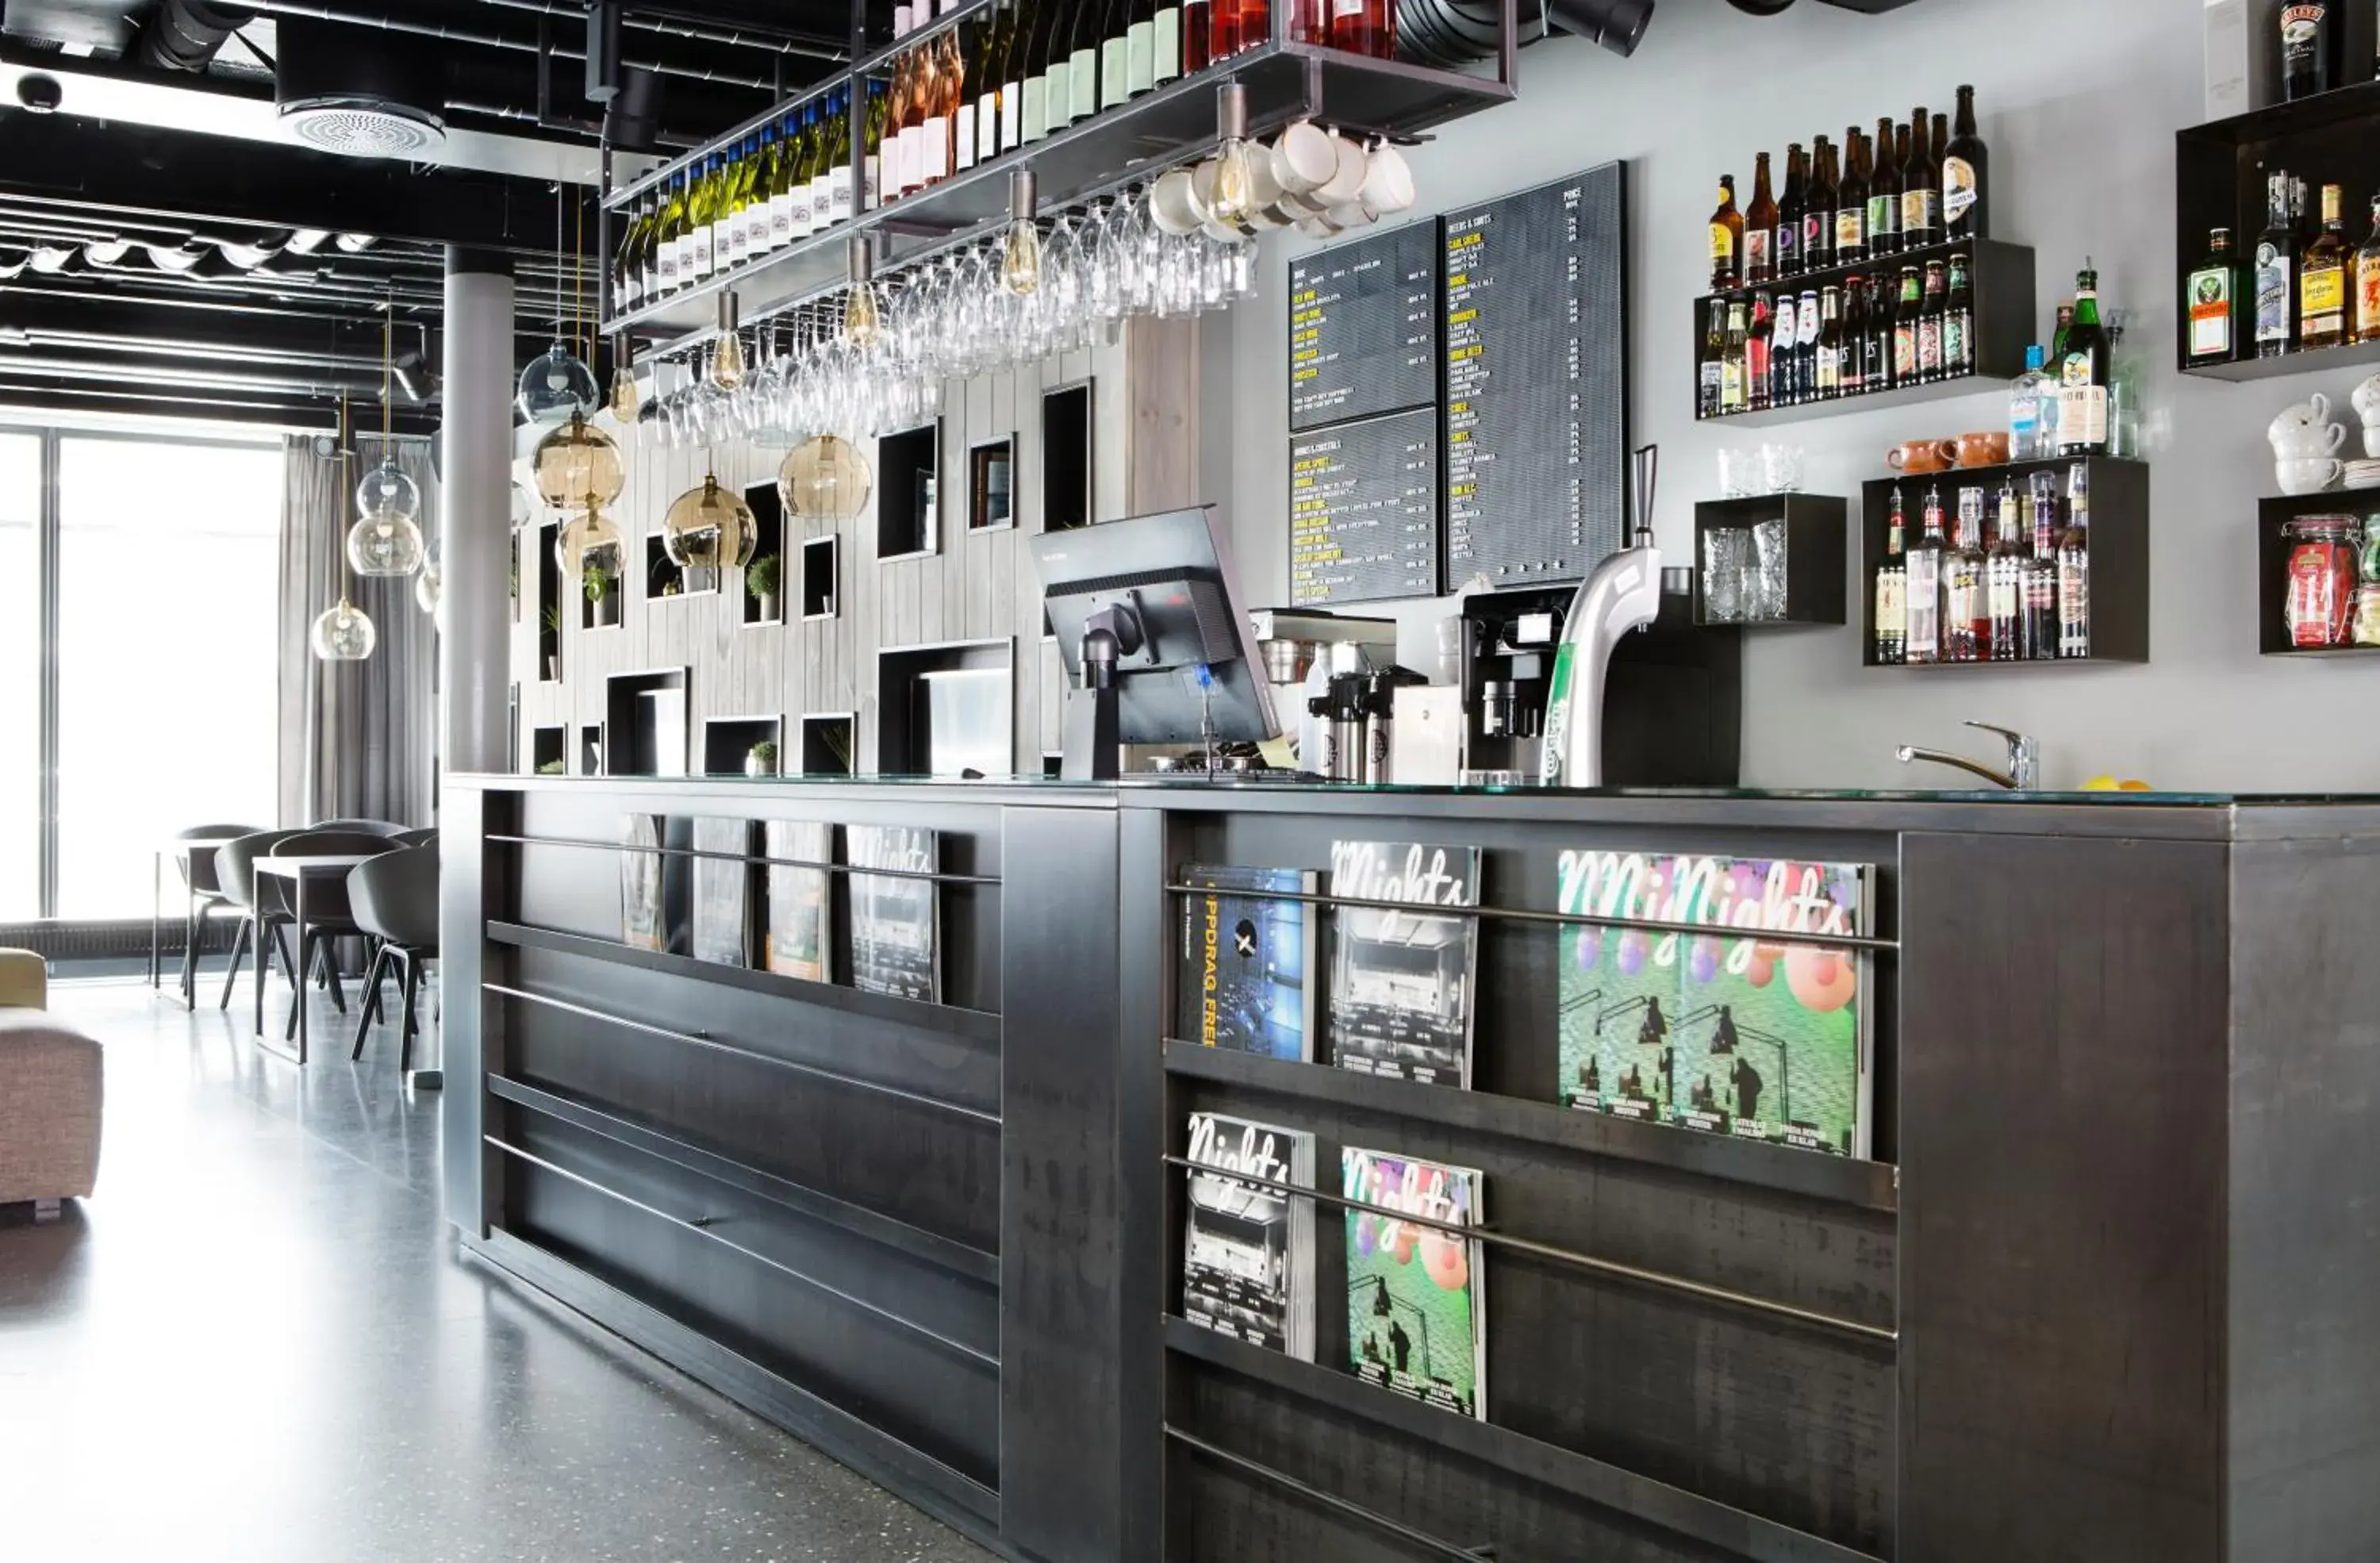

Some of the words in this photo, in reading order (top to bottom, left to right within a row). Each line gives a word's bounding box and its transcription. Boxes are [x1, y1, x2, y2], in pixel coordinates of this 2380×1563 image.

[1330, 841, 1470, 943] Nights
[1672, 854, 1853, 974] Nights
[1203, 999, 1217, 1047] FRE
[1187, 1115, 1288, 1208] Nights
[1342, 1147, 1466, 1251] Nights
